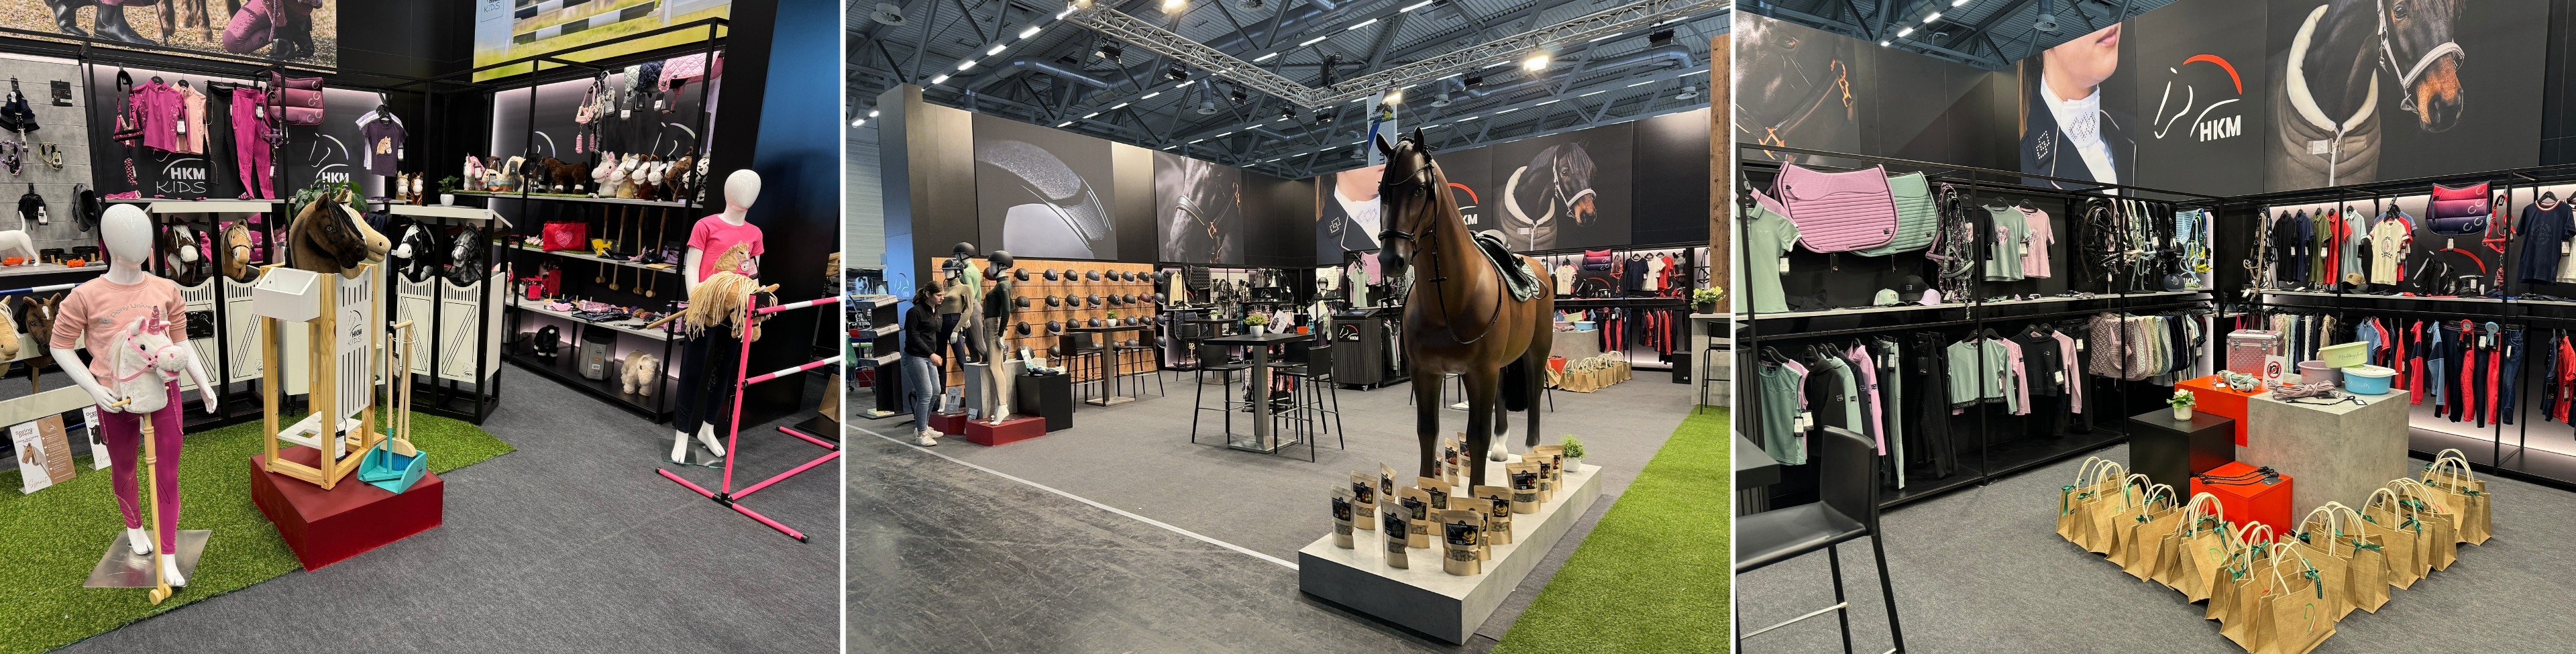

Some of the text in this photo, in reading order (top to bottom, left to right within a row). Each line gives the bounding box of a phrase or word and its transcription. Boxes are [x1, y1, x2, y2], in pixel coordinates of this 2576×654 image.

[484, 2, 500, 13] KIDS
[2200, 115, 2241, 142] HKM
[170, 167, 206, 180] HKM
[322, 172, 350, 183] HKM
[156, 180, 207, 194] KIDS
[1461, 213, 1478, 225] KM
[352, 329, 362, 337] HKM
[348, 335, 362, 346] KIDS
